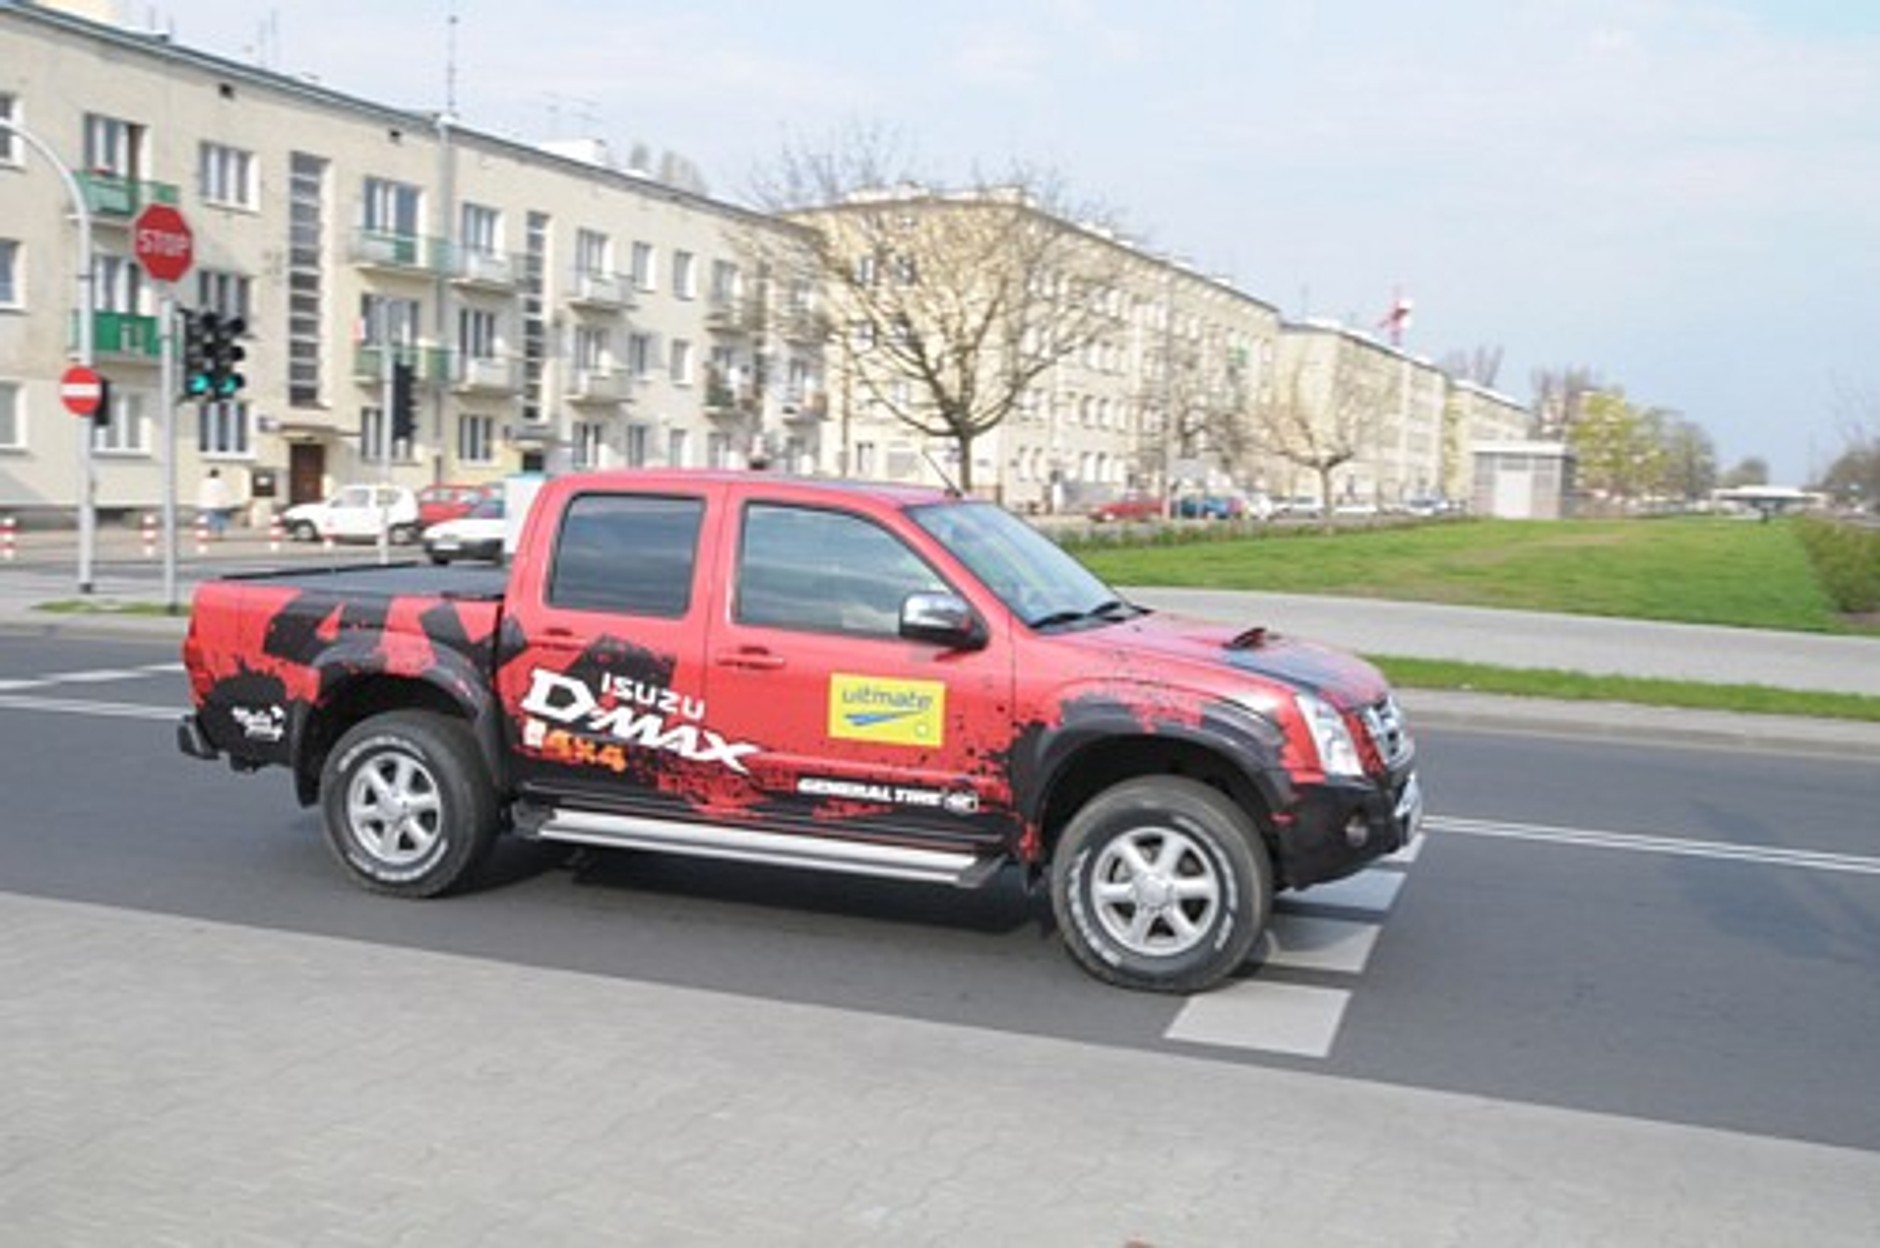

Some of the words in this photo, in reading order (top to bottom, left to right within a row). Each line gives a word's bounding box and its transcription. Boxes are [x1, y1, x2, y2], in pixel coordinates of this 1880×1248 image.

[138, 229, 189, 257] STOP
[601, 672, 706, 720] ISUZU
[519, 667, 763, 776] D-MAX
[797, 777, 893, 803] GENERAL
[894, 788, 943, 807] TIRE
